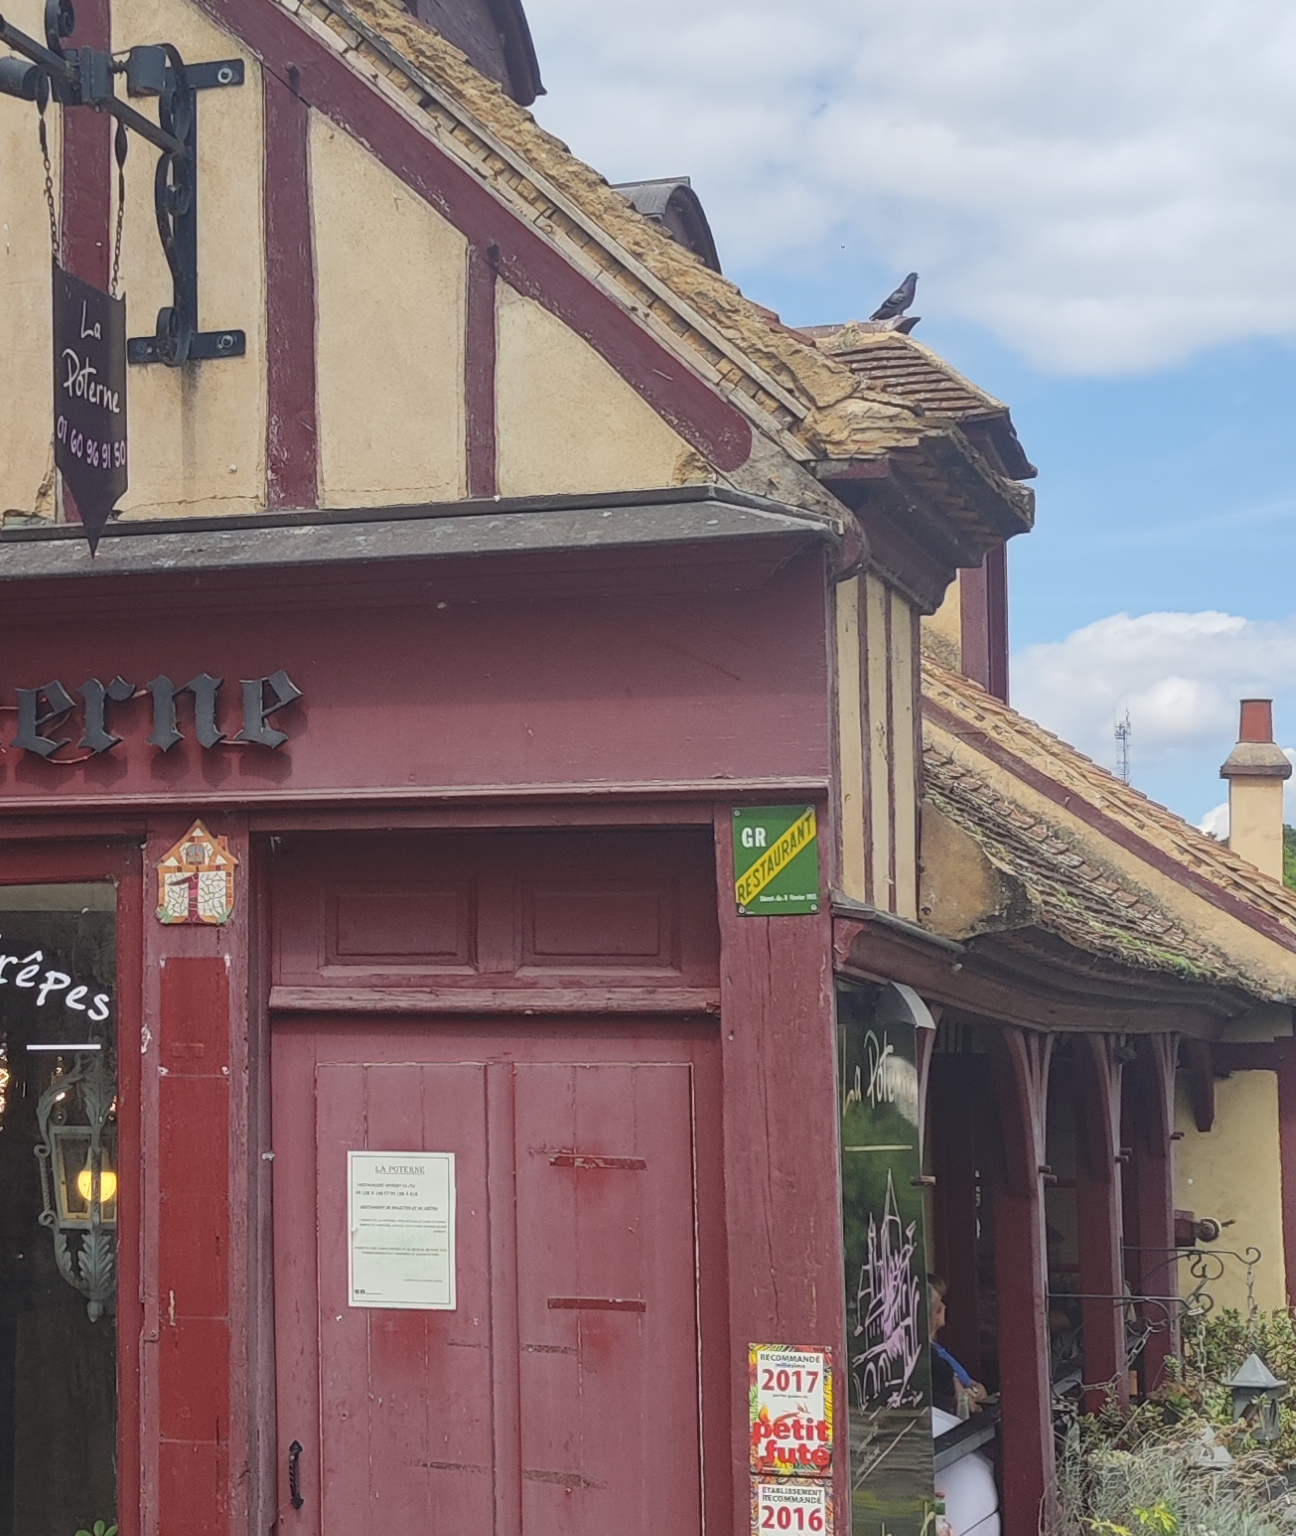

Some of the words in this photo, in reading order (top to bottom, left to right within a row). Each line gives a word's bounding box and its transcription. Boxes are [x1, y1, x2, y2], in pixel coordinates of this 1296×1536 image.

[80, 300, 101, 340] La
[61, 348, 120, 413] Poterne
[57, 415, 68, 444] 01
[70, 428, 83, 458] 60
[86, 439, 99, 467] 96
[102, 443, 111, 469] 91
[114, 440, 125, 468] 50
[741, 827, 766, 848] GR
[737, 813, 812, 901] RESTAURANT
[842, 1026, 862, 1117] La
[389, 1166, 425, 1174] POTERNE
[761, 1369, 819, 1393] 2017
[751, 1417, 830, 1445] petit
[765, 1439, 830, 1466] futé
[761, 1505, 823, 1531] 2016
